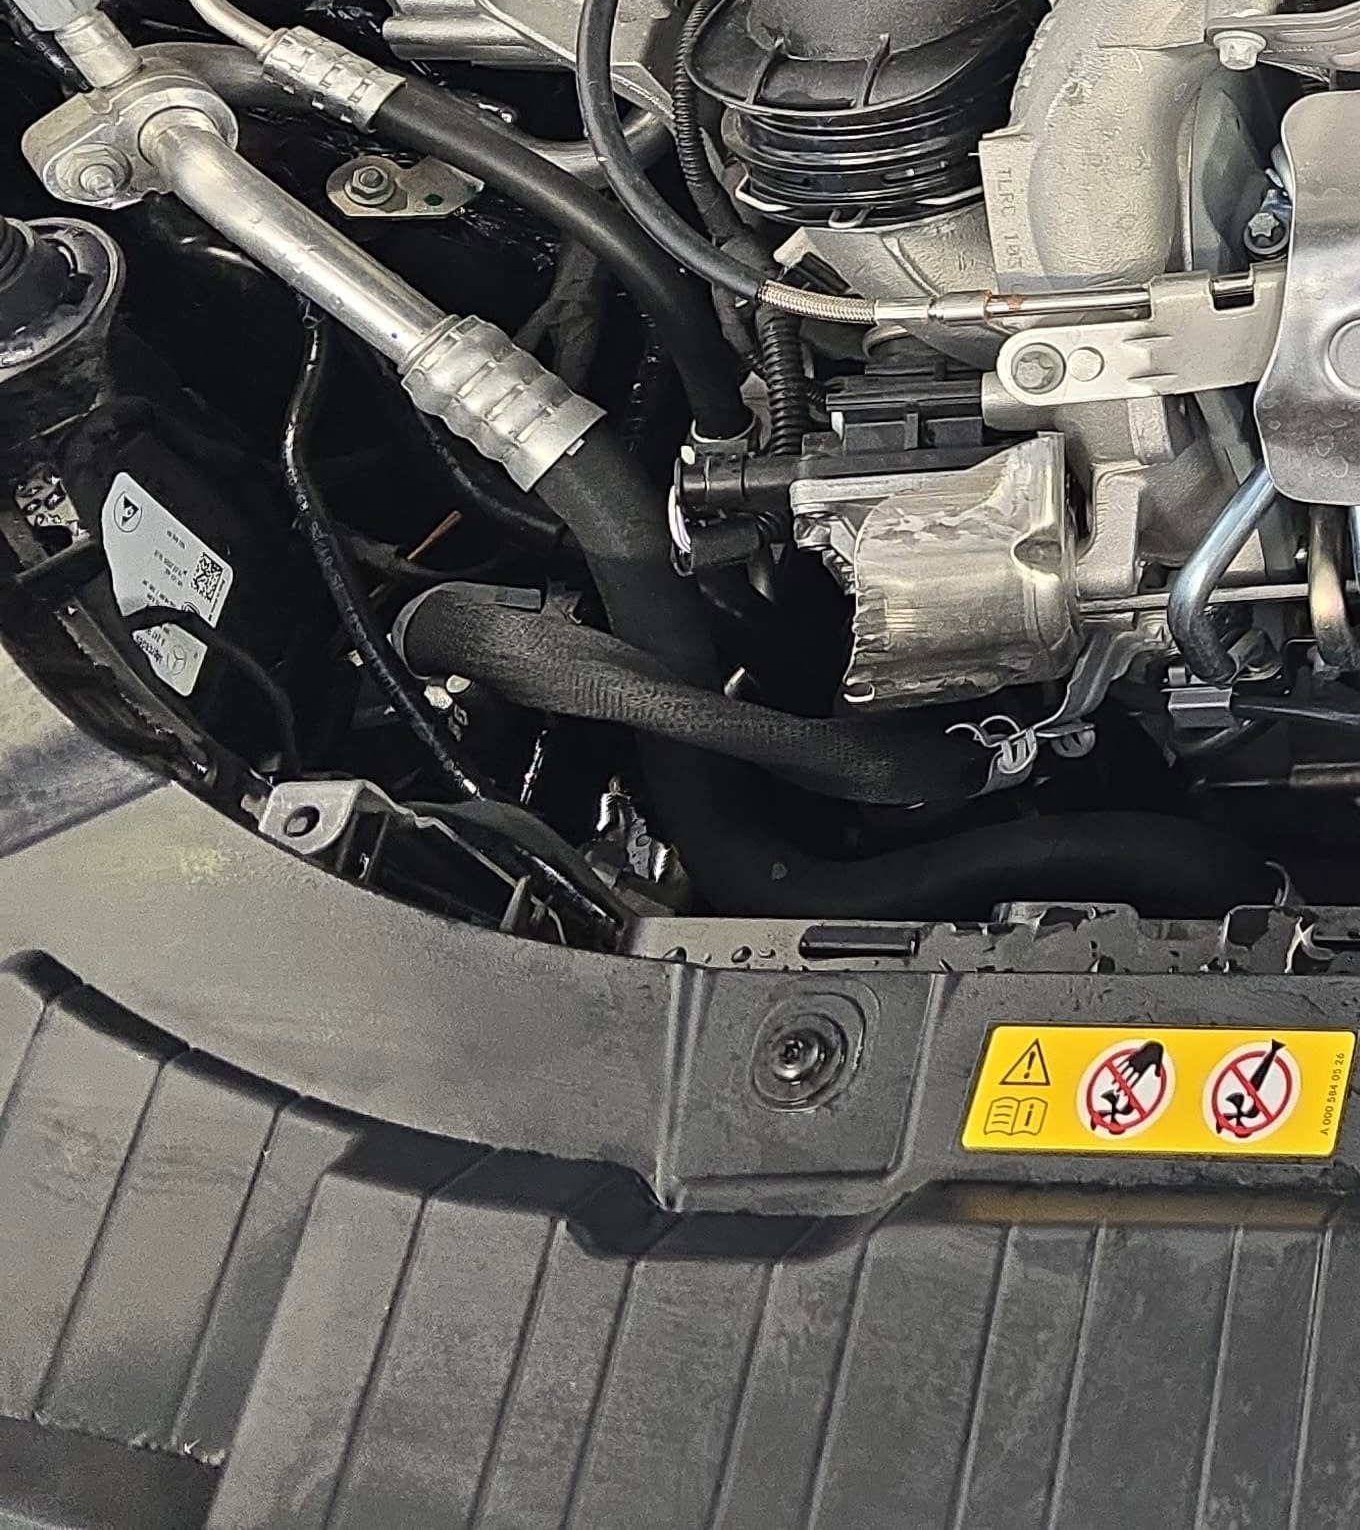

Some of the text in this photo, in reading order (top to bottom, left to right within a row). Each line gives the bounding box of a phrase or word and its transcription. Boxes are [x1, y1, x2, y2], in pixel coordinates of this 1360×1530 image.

[1320, 1052, 1345, 1136] A 000 584 05 26
